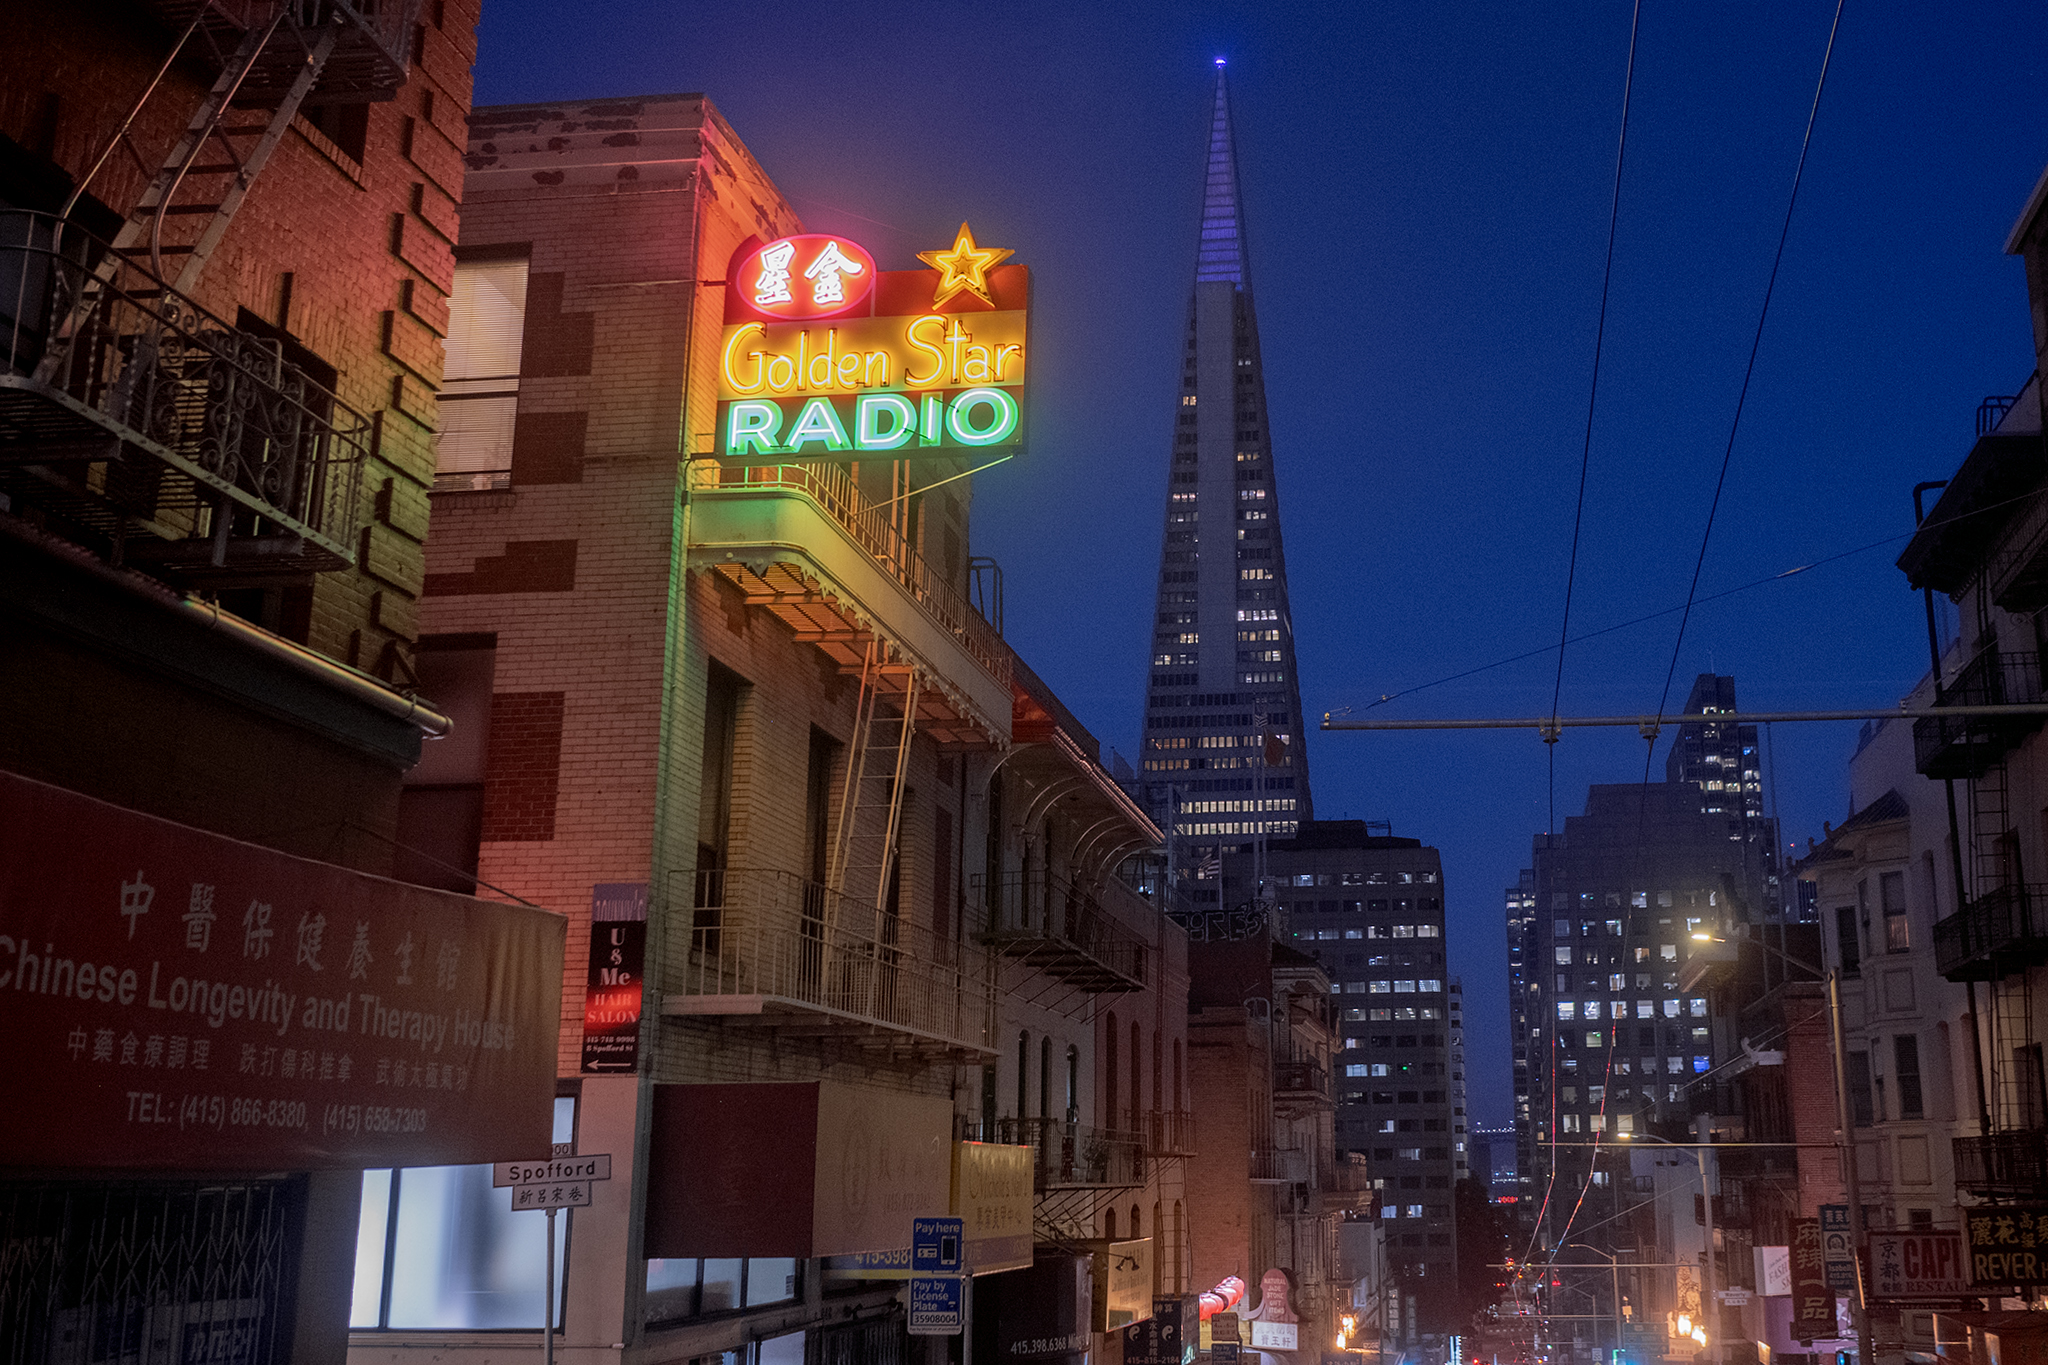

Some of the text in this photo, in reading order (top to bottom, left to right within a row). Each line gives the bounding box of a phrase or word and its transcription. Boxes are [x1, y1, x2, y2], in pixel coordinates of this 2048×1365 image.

[724, 313, 1023, 395] Golden Star
[726, 387, 1019, 456] RADIO
[611, 927, 626, 946] U
[600, 967, 632, 986] Me
[0, 934, 515, 1053] Chinese Longevity and Therapy House
[595, 993, 632, 1006] HAIR
[587, 1010, 639, 1024] SALON
[126, 1091, 173, 1124] TEL:
[179, 1094, 226, 1131] (415)
[322, 1103, 361, 1136] (415)
[509, 1161, 595, 1183] Spofford
[519, 1186, 583, 1205] 新呂宋巷
[915, 1221, 960, 1235] Pay here
[1974, 1252, 2038, 1281] REVER
[913, 1280, 946, 1292] Pay by
[913, 1291, 949, 1301] License
[913, 1301, 938, 1311] Plate
[914, 1314, 956, 1323] 35908004
[1010, 1337, 1067, 1355] 415.398.6368
